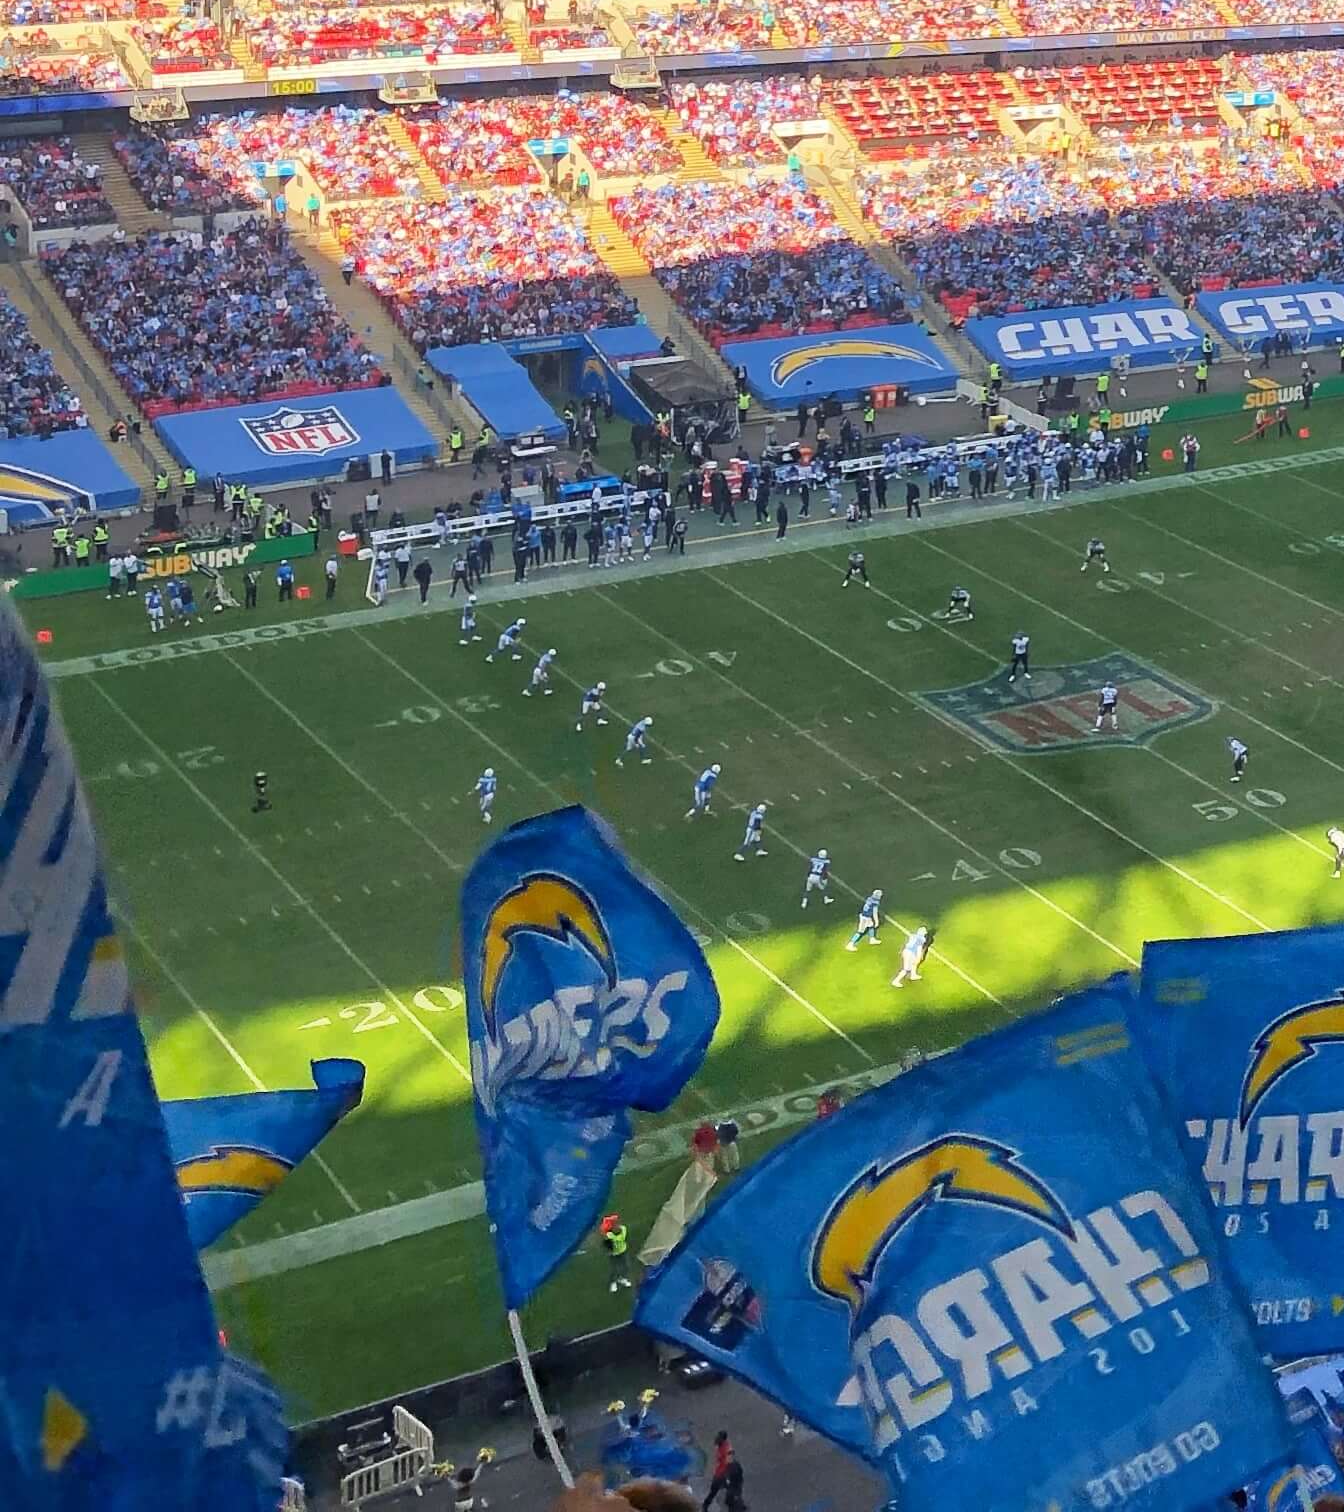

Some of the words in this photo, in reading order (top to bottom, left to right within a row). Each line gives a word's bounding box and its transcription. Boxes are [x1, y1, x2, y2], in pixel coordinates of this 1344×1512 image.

[272, 80, 315, 95] 15:00
[997, 307, 1201, 361] CHAR
[264, 426, 348, 453] NFL
[143, 542, 257, 580] SUBWAY
[90, 618, 330, 669] LONDON
[655, 648, 740, 679] 40
[400, 694, 500, 726] 30
[985, 679, 1194, 746] NFL
[118, 744, 224, 780] 20
[1191, 787, 1288, 824] 50
[949, 846, 1044, 885] 40
[338, 985, 465, 1036] 20
